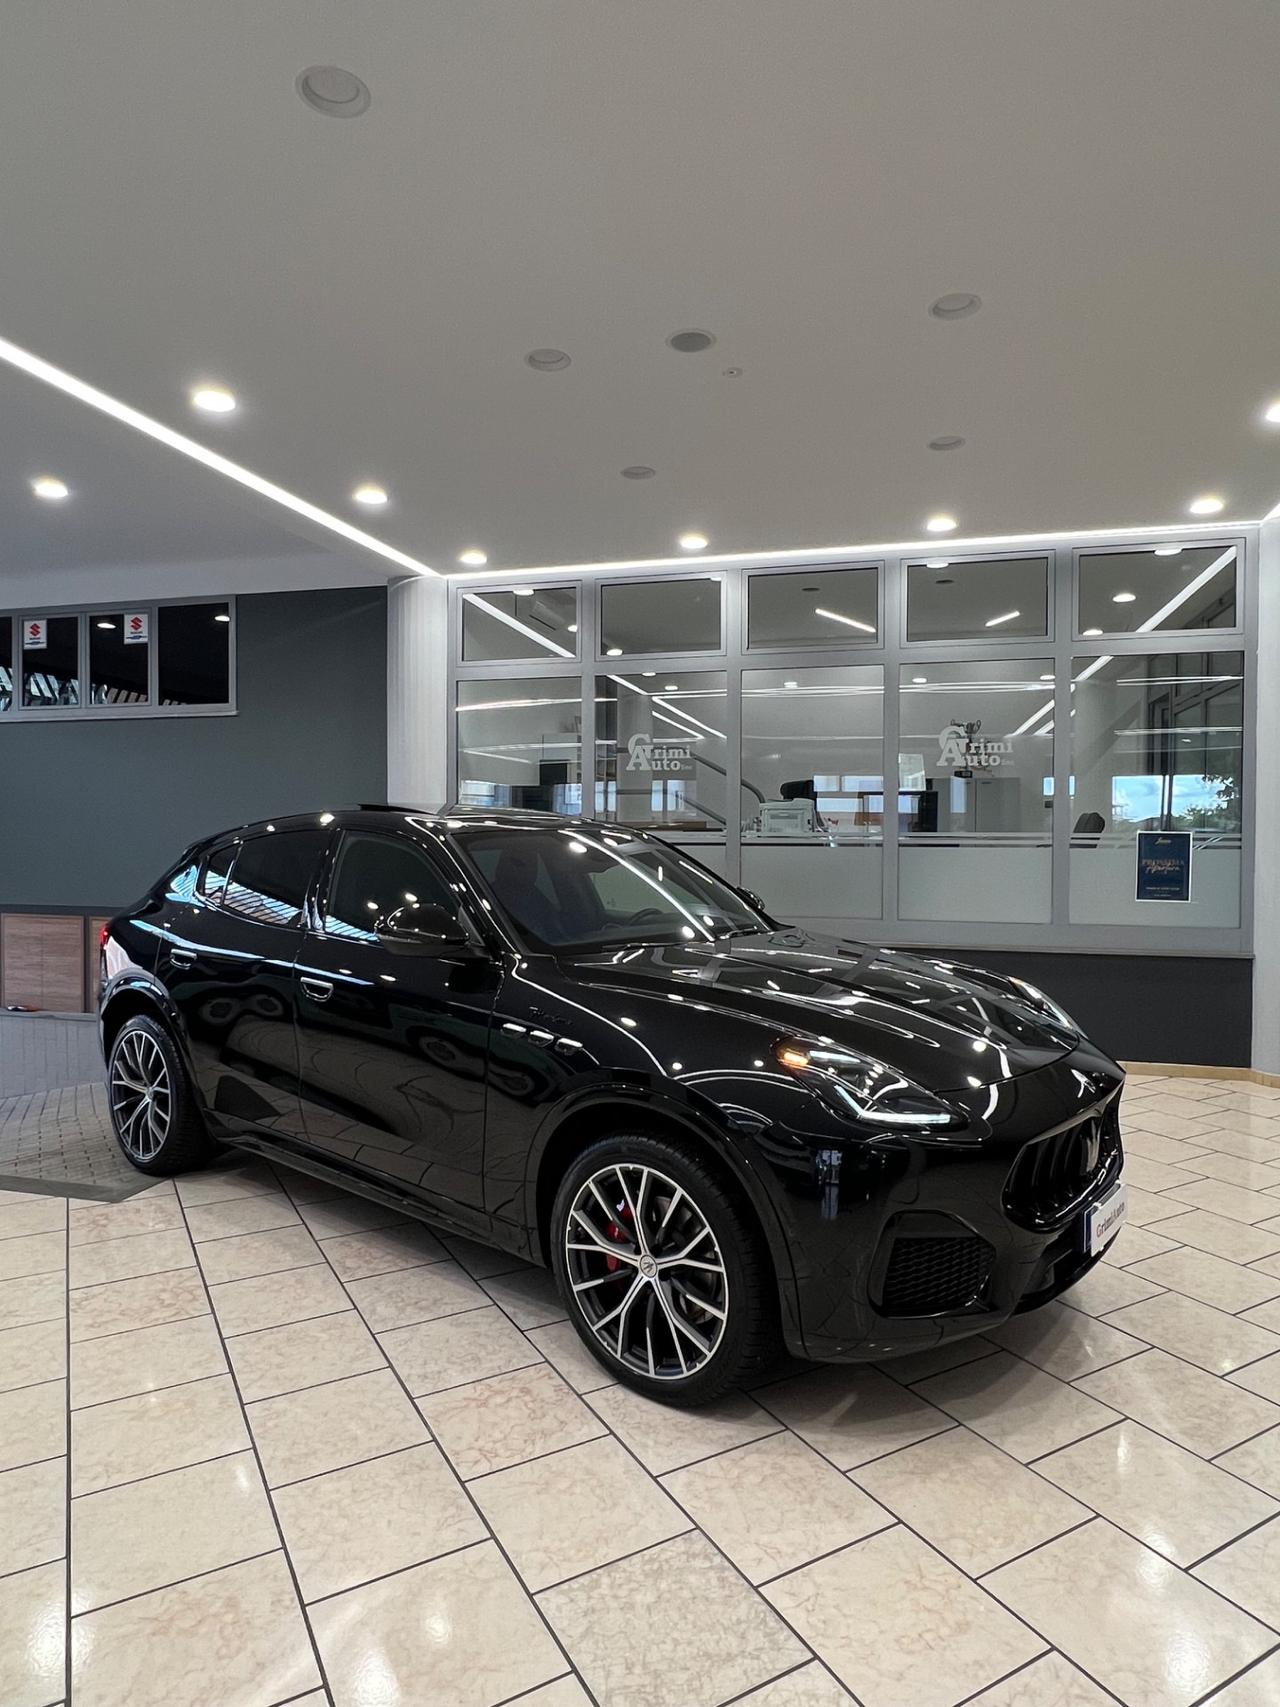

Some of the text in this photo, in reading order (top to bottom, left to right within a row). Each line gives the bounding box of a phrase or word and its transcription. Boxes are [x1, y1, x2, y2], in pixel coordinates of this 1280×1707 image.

[628, 733, 691, 759] Grimi
[936, 739, 1001, 766] Auto
[939, 726, 1014, 753] Grimi
[626, 745, 681, 770] Auto
